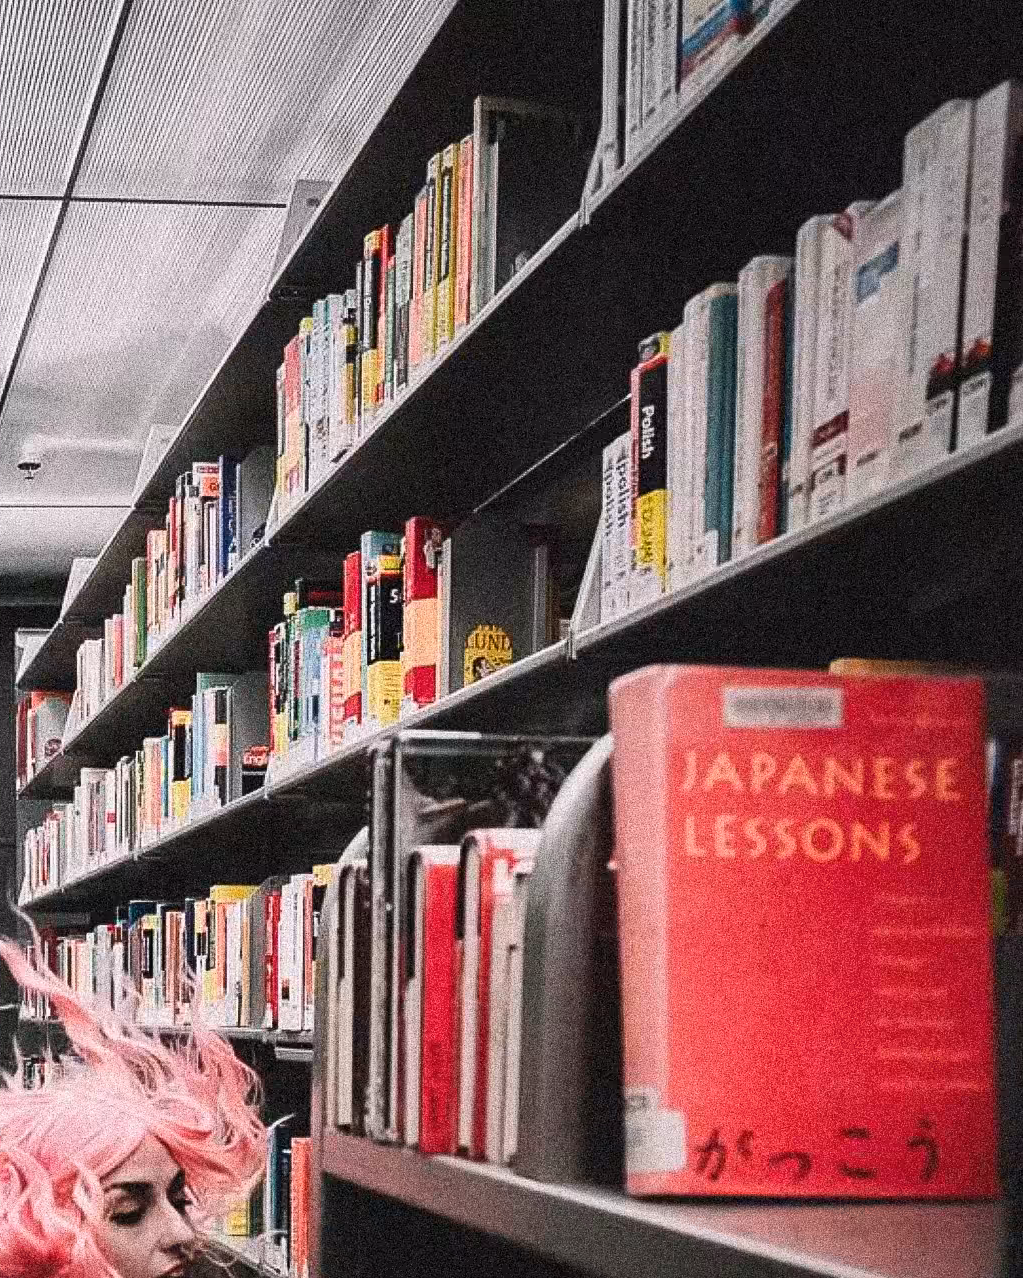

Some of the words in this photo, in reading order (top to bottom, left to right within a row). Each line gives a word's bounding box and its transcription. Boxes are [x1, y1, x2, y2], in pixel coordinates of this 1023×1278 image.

[640, 405, 655, 460] Polish
[683, 750, 961, 800] JAPANESE
[684, 814, 922, 865] LESSONS
[694, 1118, 939, 1182] がっこう
